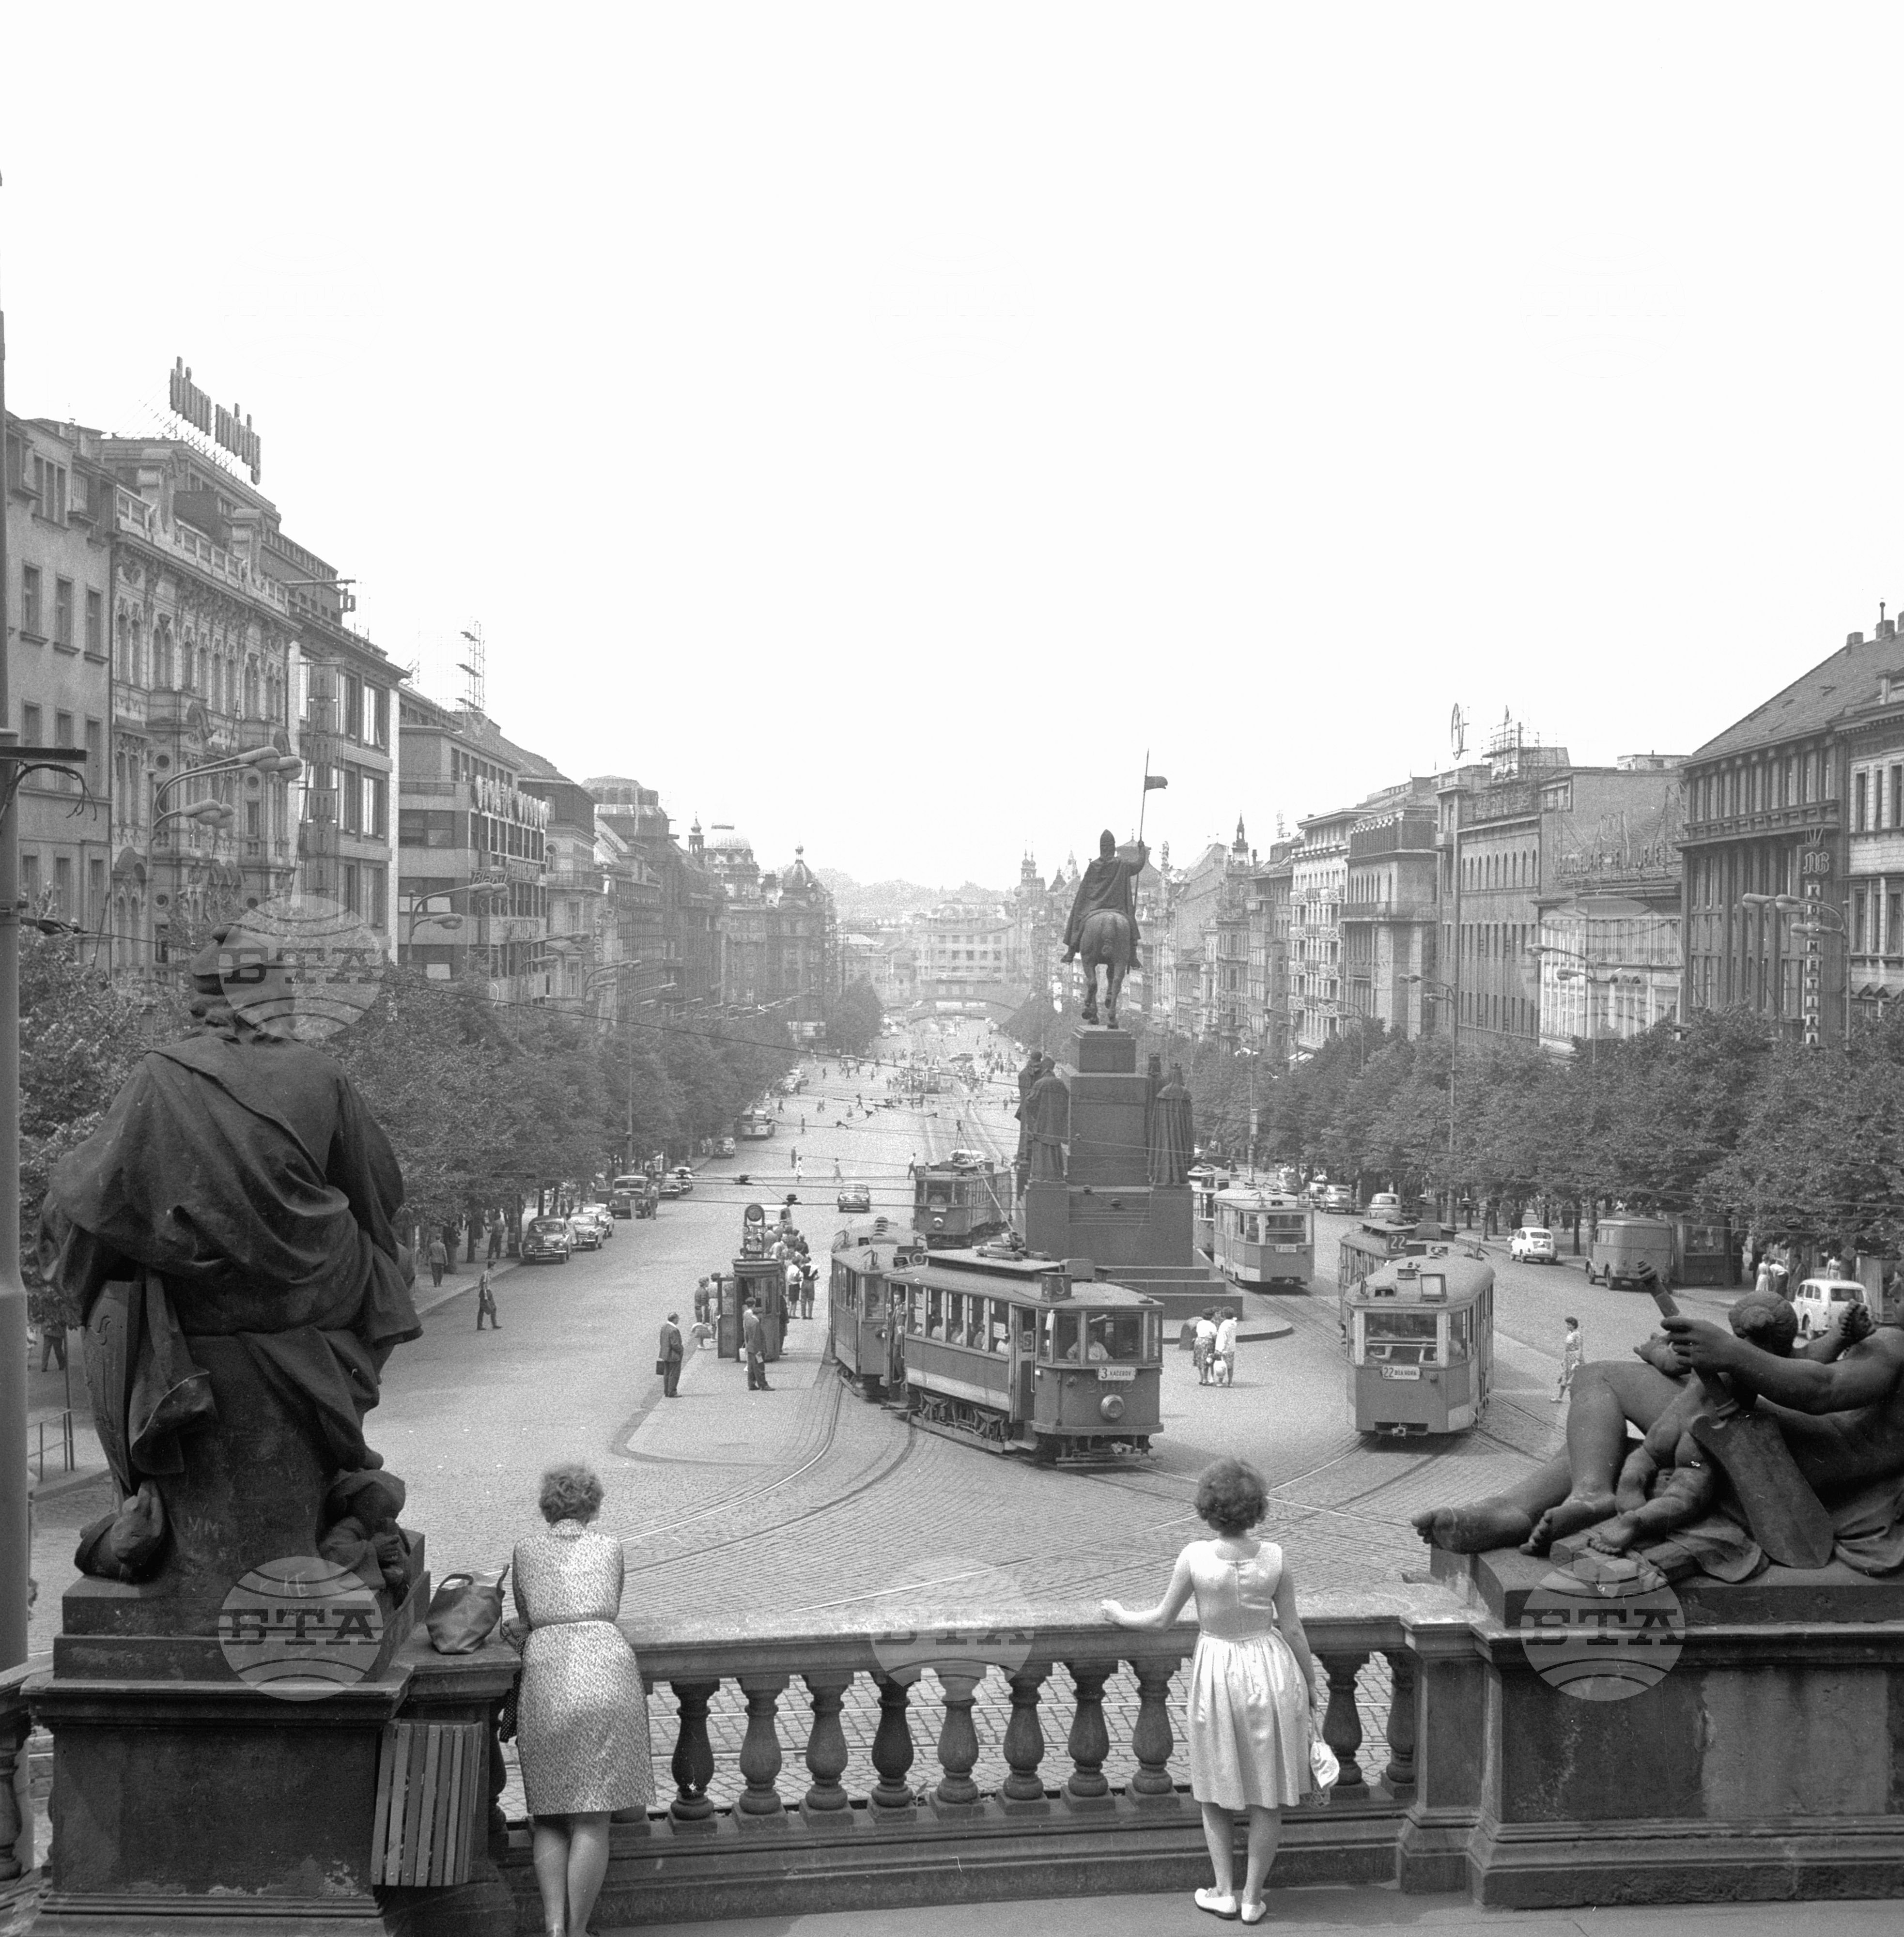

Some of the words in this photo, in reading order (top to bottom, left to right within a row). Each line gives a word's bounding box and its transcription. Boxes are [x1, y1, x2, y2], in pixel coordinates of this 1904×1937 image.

[1808, 885, 1820, 1044] KOMETIKA
[1391, 1235, 1405, 1249] 22
[1056, 1277, 1065, 1294] 3
[1101, 1368, 1108, 1379] 3
[1384, 1367, 1394, 1378] 22
